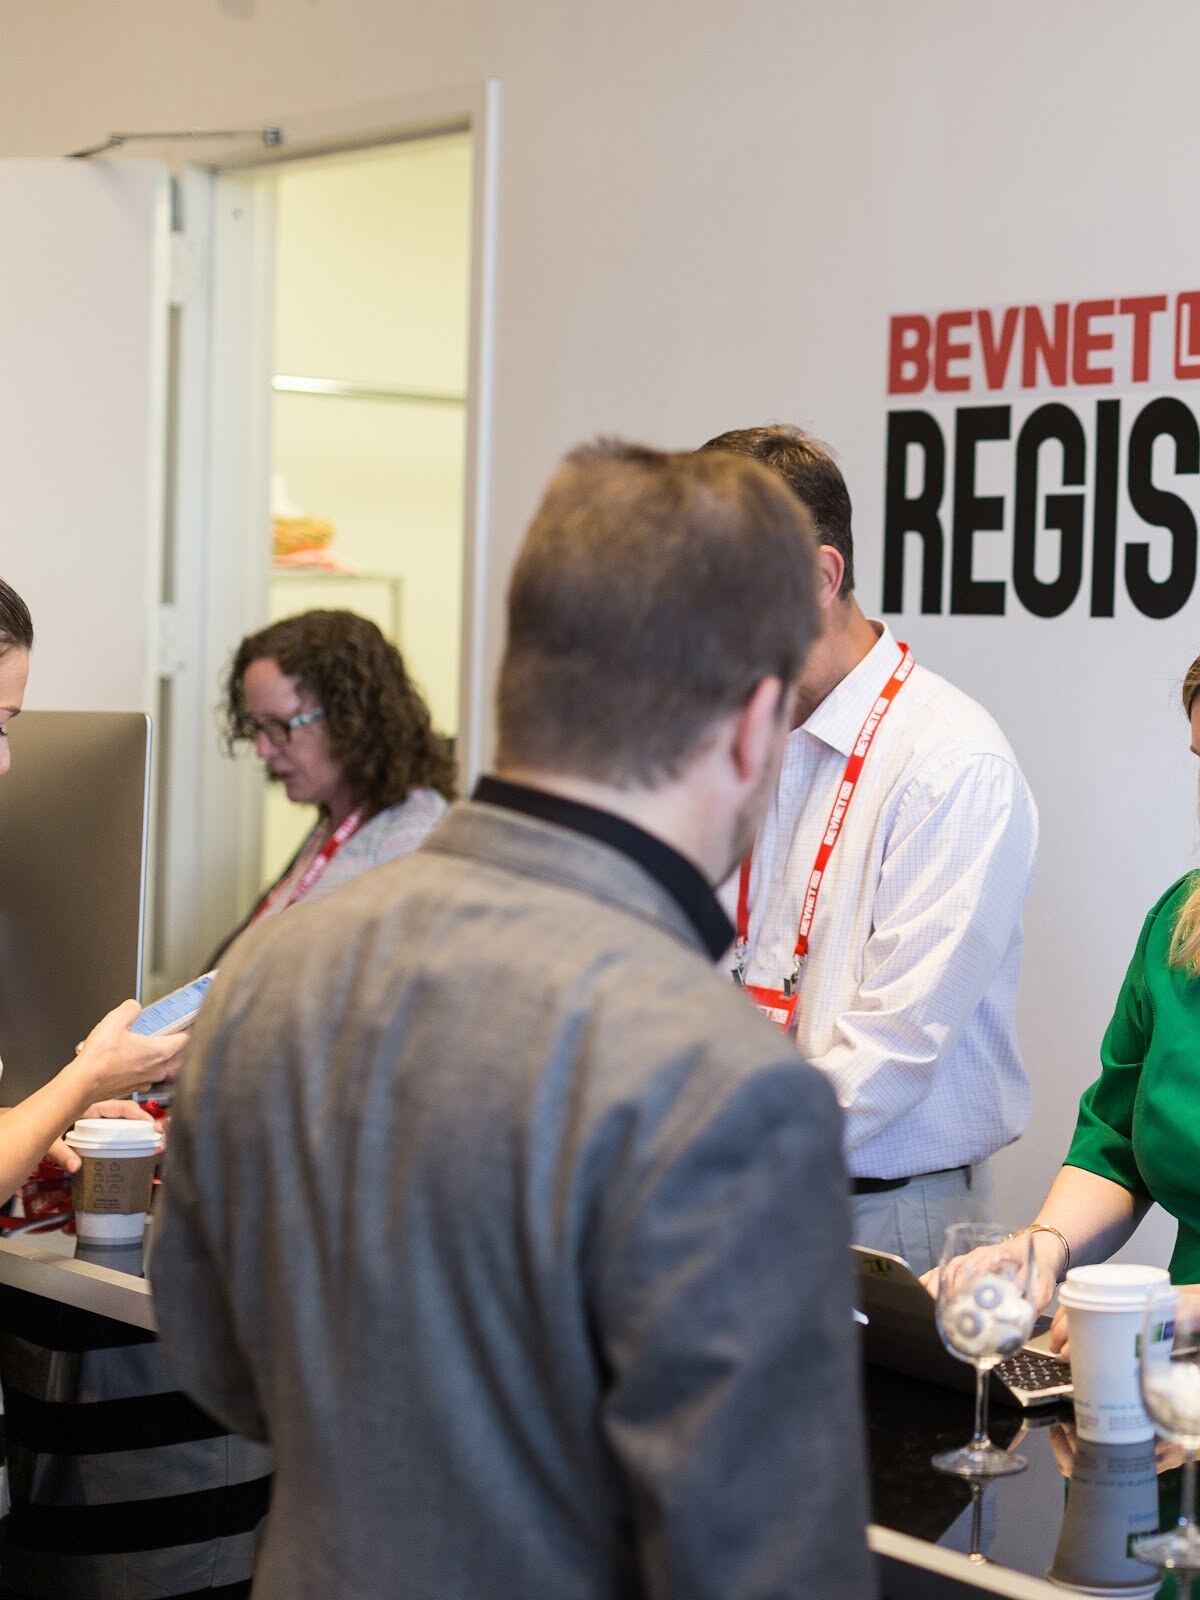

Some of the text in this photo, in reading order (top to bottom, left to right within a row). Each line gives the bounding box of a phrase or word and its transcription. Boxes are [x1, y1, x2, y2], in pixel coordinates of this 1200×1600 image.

[888, 295, 1166, 393] BEVNET
[853, 712, 883, 757] BEVNET
[823, 796, 848, 846] BEVNET
[800, 885, 818, 936] BEVNET
